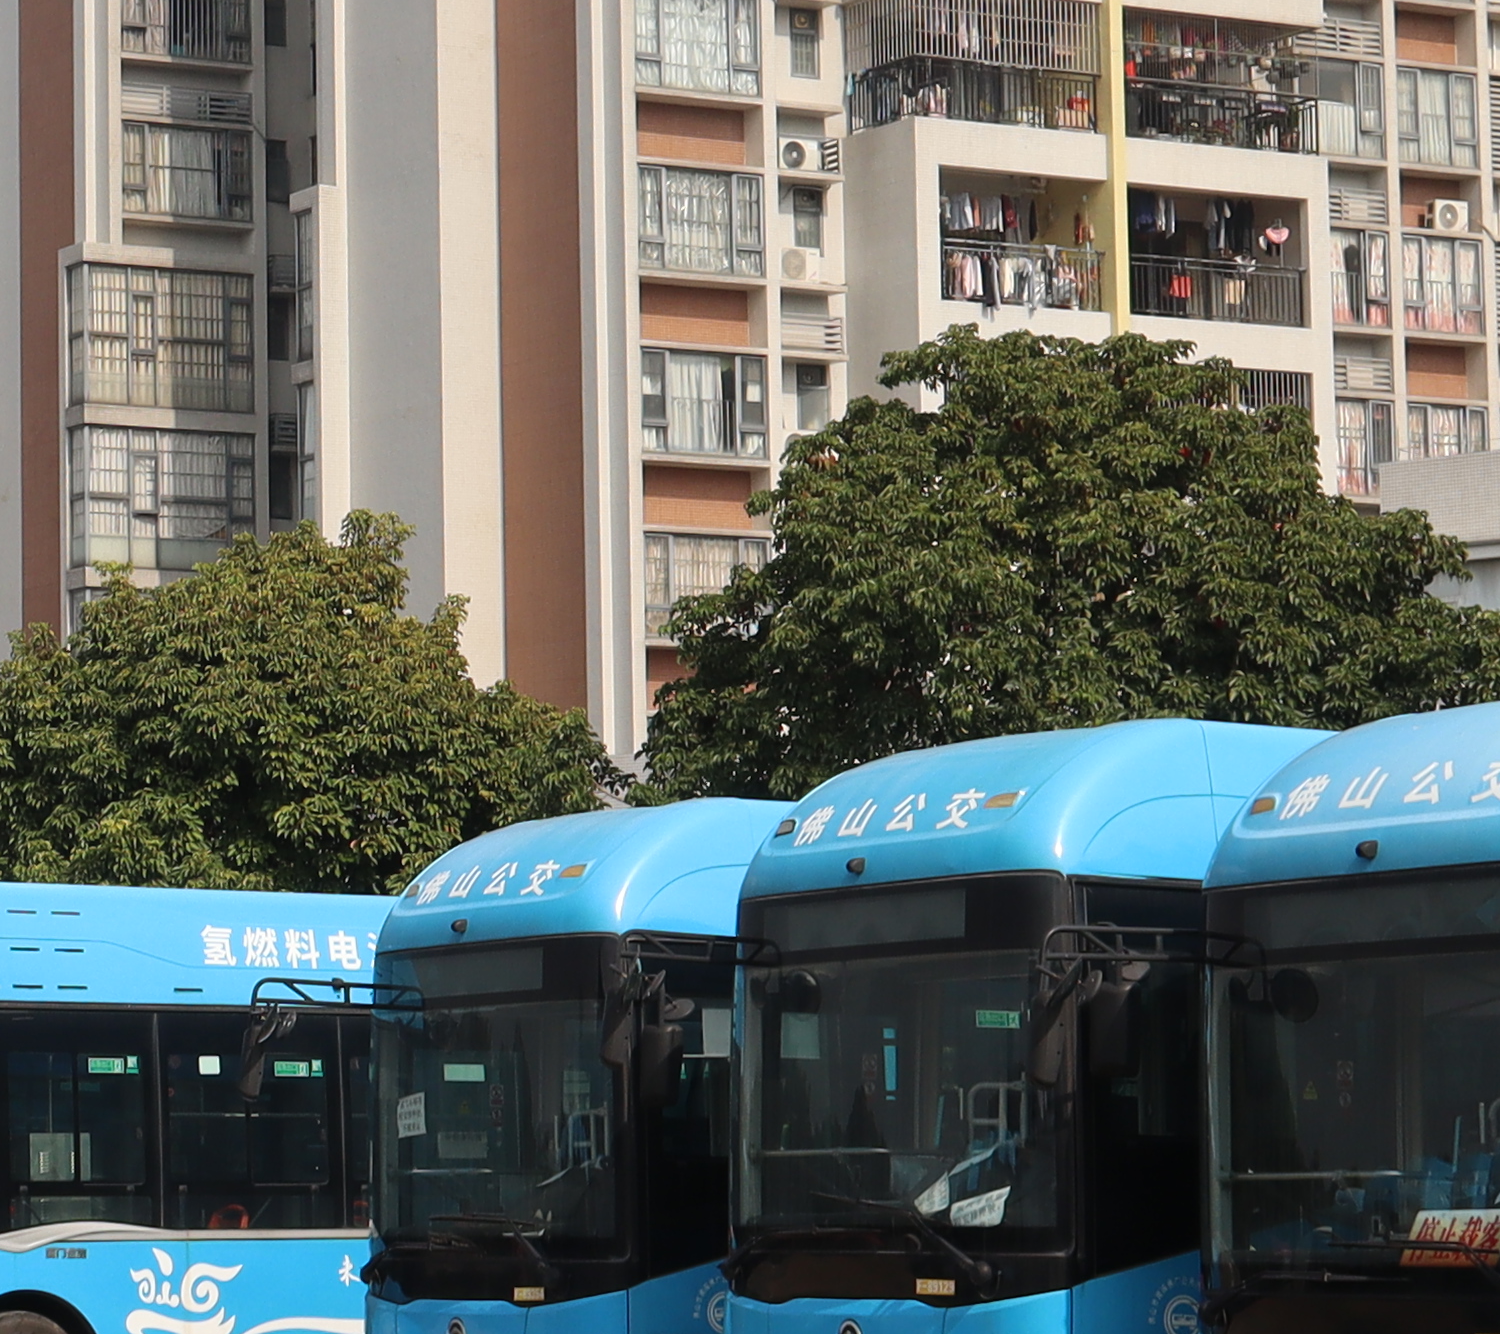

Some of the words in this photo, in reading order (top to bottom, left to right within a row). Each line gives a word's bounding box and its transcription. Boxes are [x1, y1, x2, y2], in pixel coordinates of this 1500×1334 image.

[794, 787, 985, 847] 佛山公交
[416, 859, 561, 906] 佛山公交
